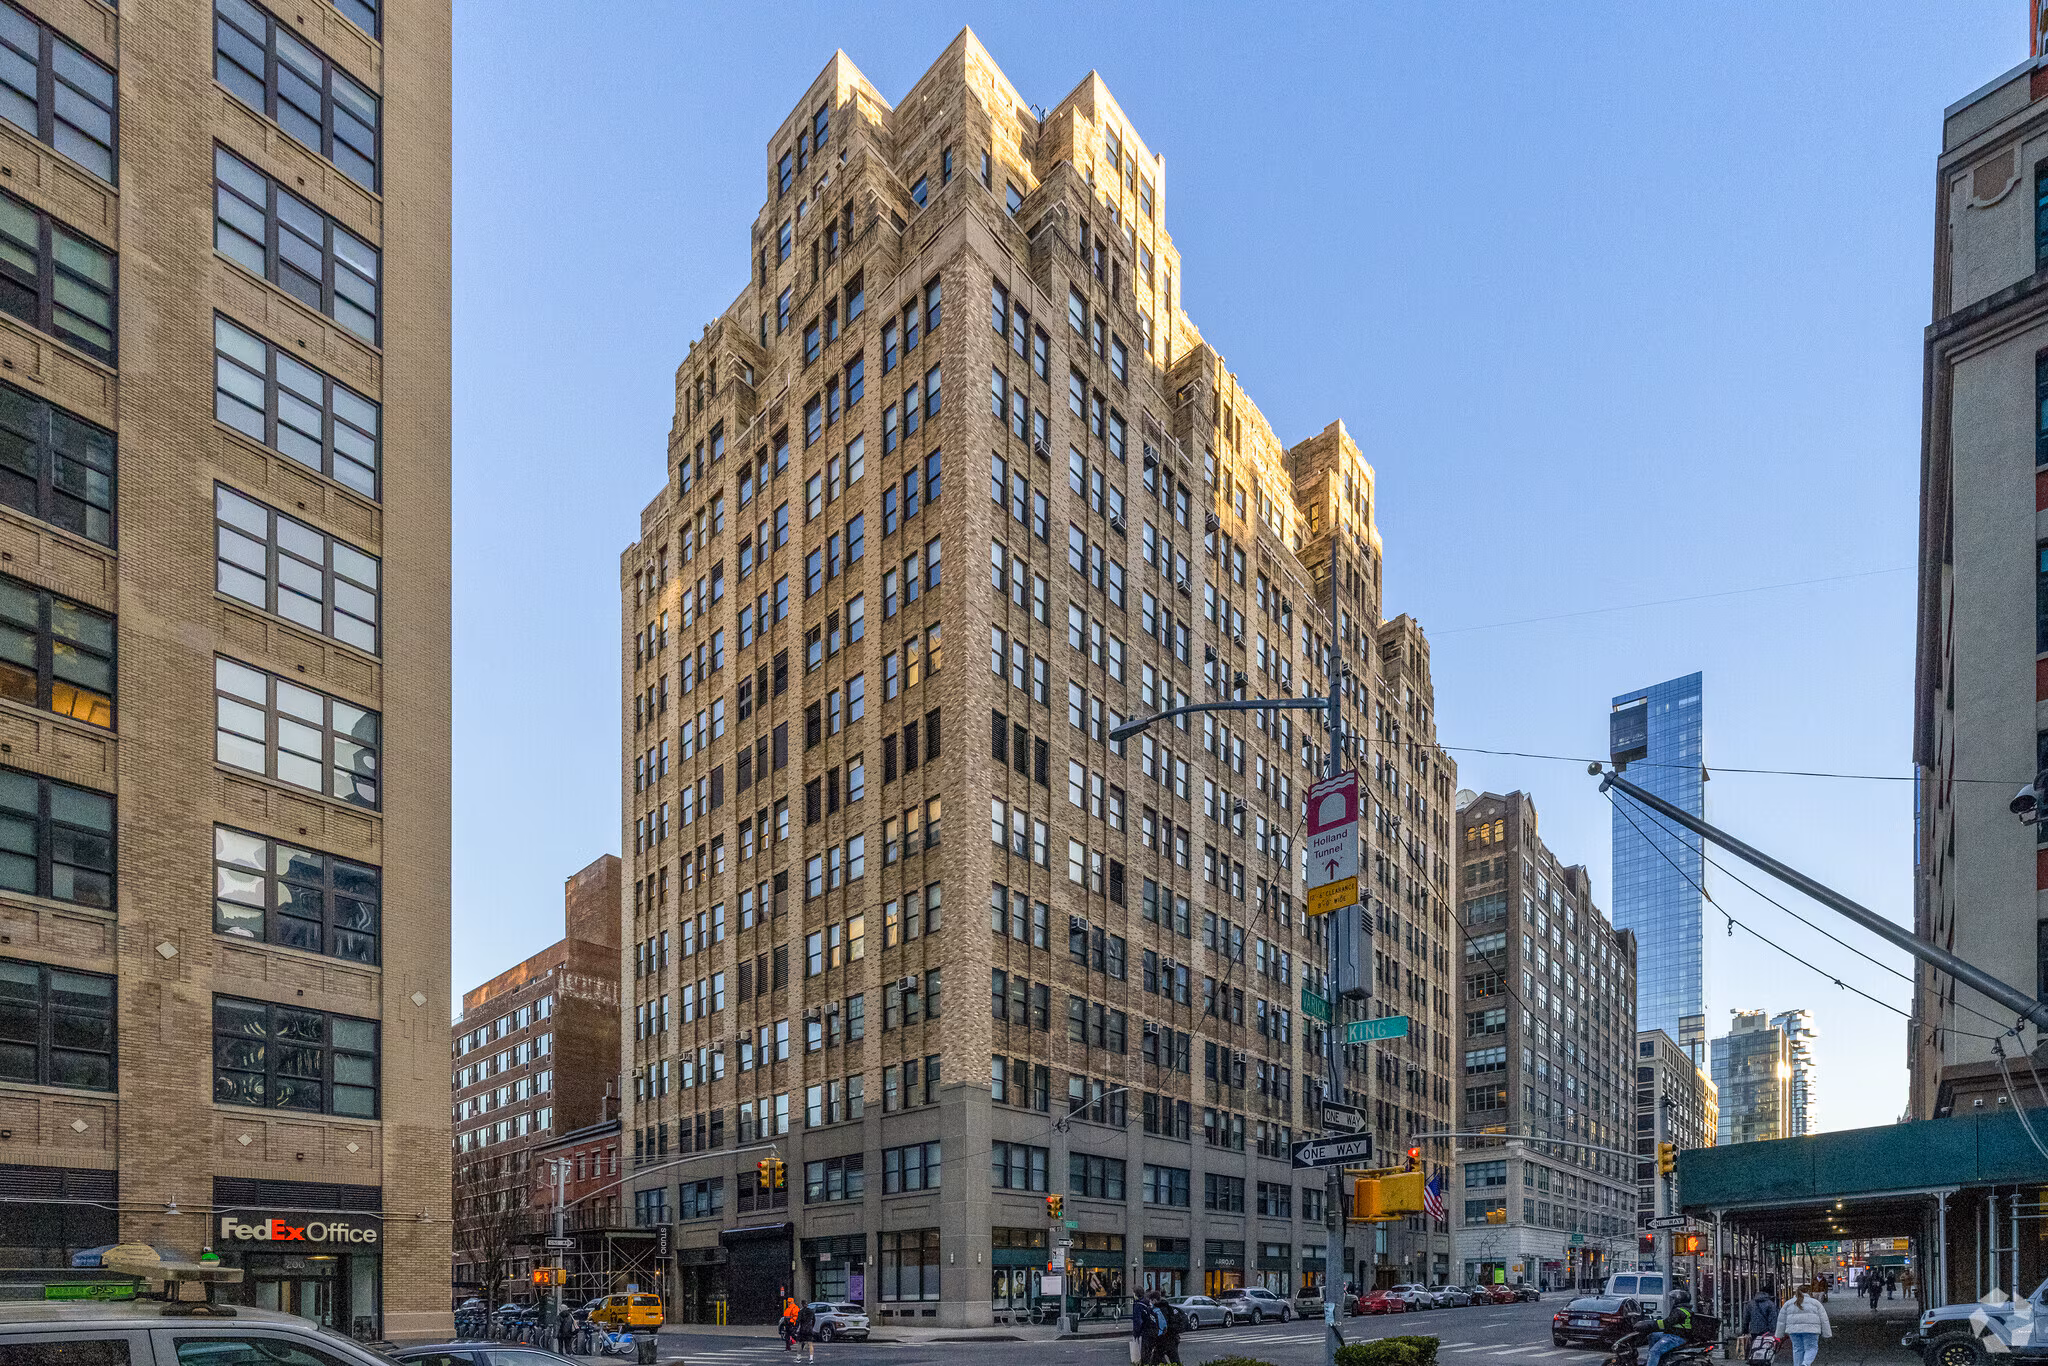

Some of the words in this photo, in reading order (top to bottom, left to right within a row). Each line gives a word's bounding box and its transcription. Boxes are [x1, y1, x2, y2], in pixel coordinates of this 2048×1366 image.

[1313, 829, 1348, 848] Holland
[1314, 843, 1343, 859] Tunnel
[1326, 883, 1355, 897] CLEARANCE
[1303, 991, 1326, 1018] VARICK
[1349, 1021, 1386, 1041] KING
[1326, 1110, 1340, 1123] ONE
[1346, 1114, 1361, 1127] WAY
[1303, 1147, 1326, 1160] ONE
[1336, 1142, 1362, 1155] WAY
[221, 1217, 305, 1241] FedEx
[306, 1222, 377, 1243] Office
[543, 1272, 549, 1282] 5
